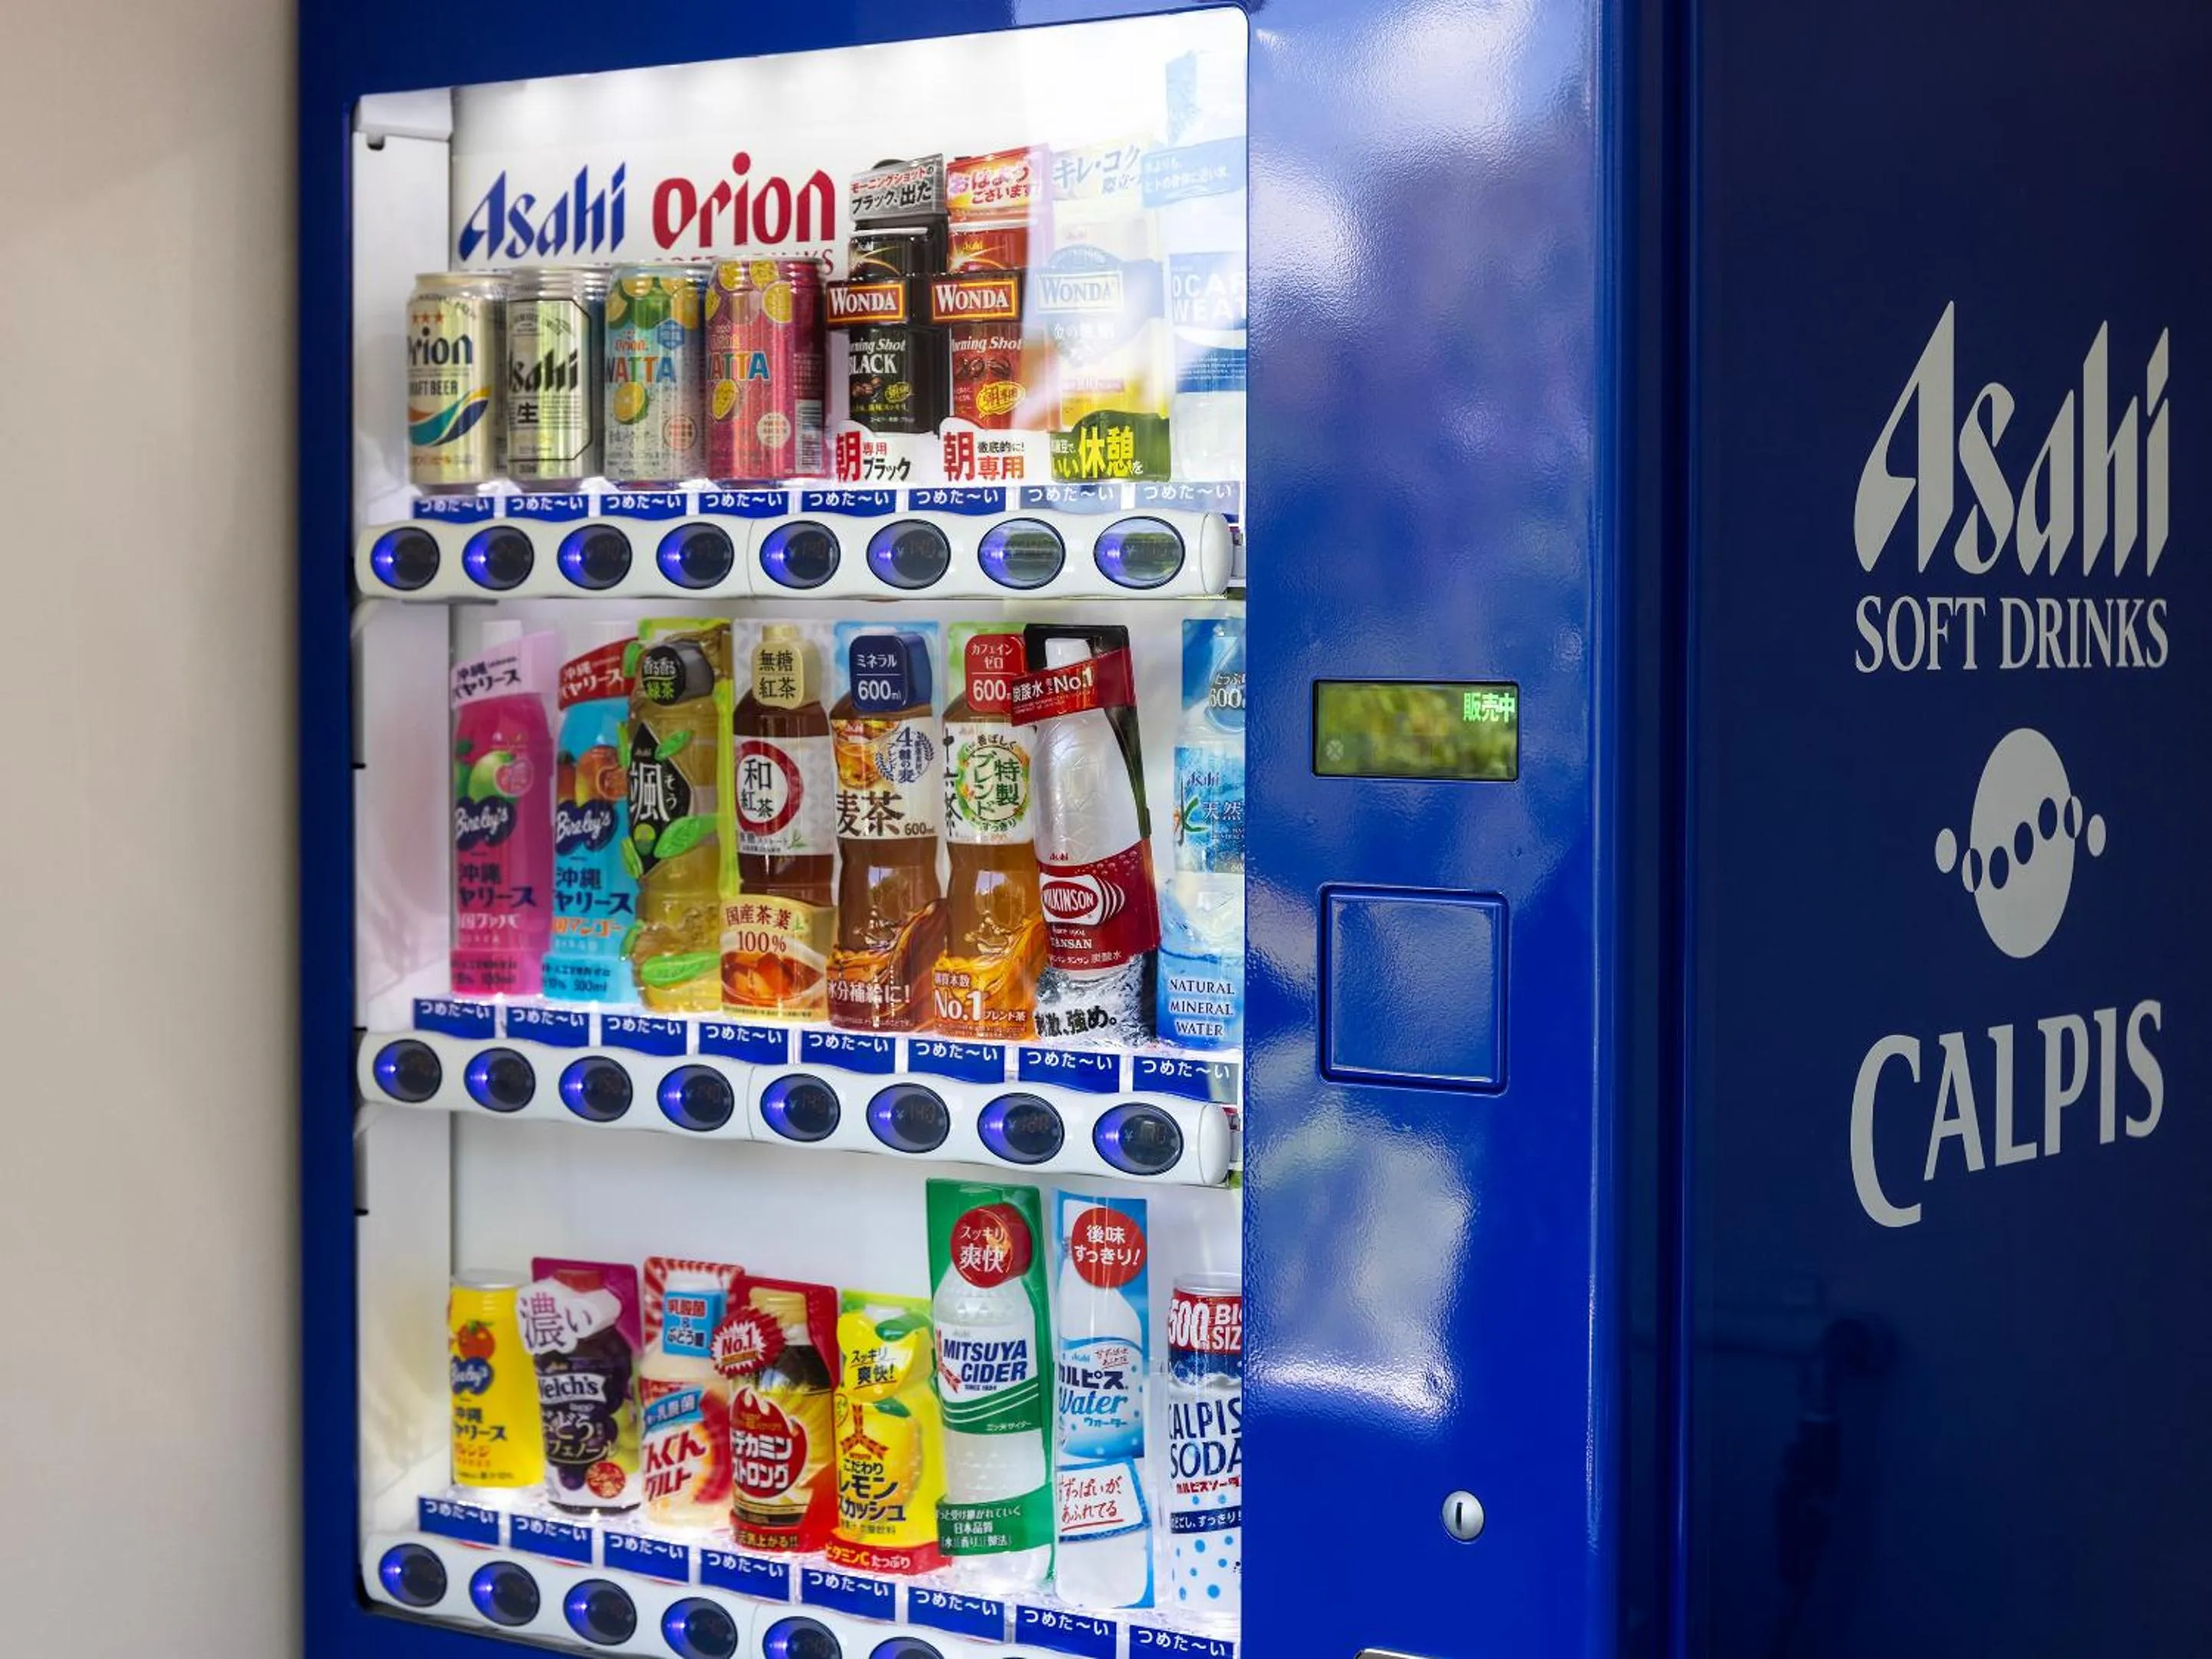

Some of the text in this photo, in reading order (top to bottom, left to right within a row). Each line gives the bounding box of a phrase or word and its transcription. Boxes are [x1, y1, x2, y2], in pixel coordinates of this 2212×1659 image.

[458, 161, 626, 261] Asahi
[830, 286, 897, 316] WONDA
[935, 283, 1009, 313] WONDA
[1039, 276, 1113, 304] WONDA
[408, 326, 472, 366] rion
[709, 350, 770, 381] ATTA
[518, 402, 540, 423] 生
[862, 441, 888, 455] 専用
[1853, 300, 2169, 577] Asahi
[836, 430, 862, 482] 朝
[943, 430, 975, 482] 朝
[977, 456, 1025, 480] 専用
[863, 459, 912, 482] ブラック
[1855, 595, 2169, 674] SOFT DRINKS
[759, 650, 793, 672] 無糖
[856, 654, 897, 669] ミネラル
[971, 644, 1013, 656] カフェイン
[983, 656, 1004, 669] ゼロ
[759, 677, 796, 700] 紅茶
[1053, 665, 1093, 694] No.1
[1463, 692, 1515, 723] 販売中
[972, 750, 997, 816] ブレンド
[995, 758, 1021, 806] 特製
[836, 790, 906, 837] 麦茶
[725, 903, 792, 930] 国産茶葉
[737, 930, 787, 953] 100%
[1169, 979, 1234, 995] NATURAL
[934, 988, 982, 1022] No.1
[1169, 999, 1233, 1015] MINERAL
[1175, 1021, 1224, 1036] WATER
[1849, 998, 2164, 1228] CALPIS
[960, 1225, 1005, 1242] スッキリ
[1086, 1224, 1126, 1245] 後味
[959, 1243, 1005, 1273] 爽快
[1074, 1245, 1141, 1267] すっきり!
[519, 1293, 593, 1348] 濃い
[1214, 1303, 1242, 1326] BI
[943, 1338, 1028, 1363] MITSUYA
[1212, 1326, 1241, 1350] SIZ
[961, 1362, 1028, 1383] CIDER
[541, 1376, 598, 1399] elch's
[1169, 1396, 1241, 1441] ALPIS
[547, 1440, 614, 1459] フェノール
[1170, 1437, 1241, 1480] SODA
